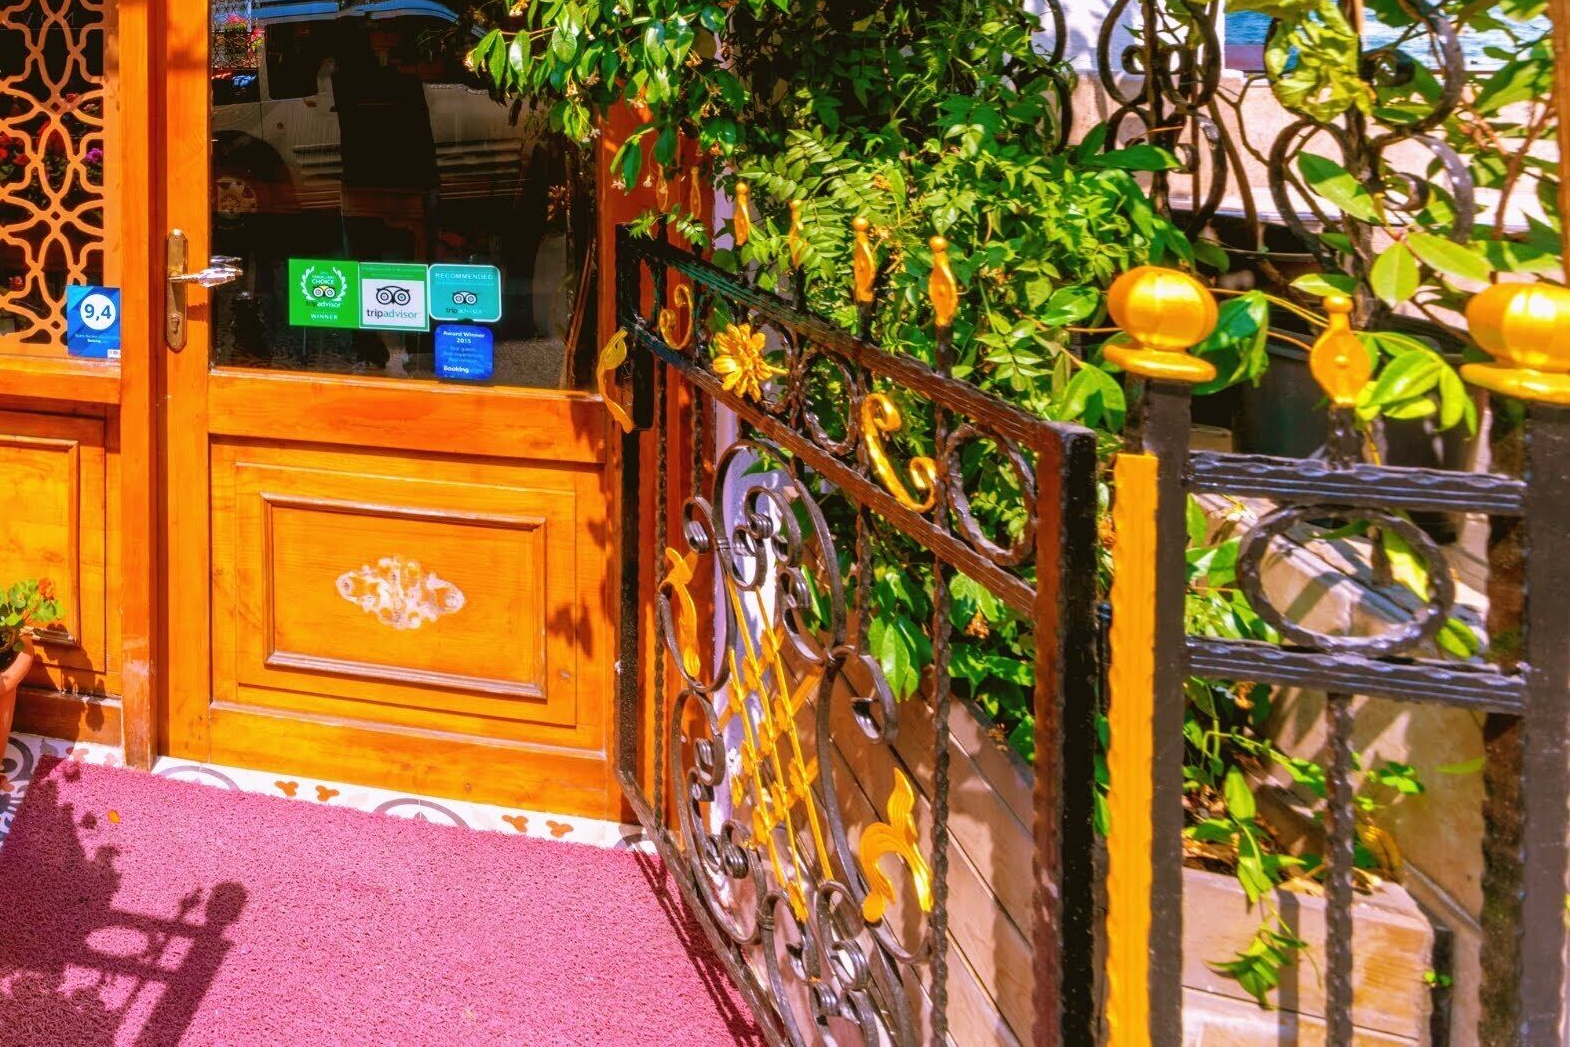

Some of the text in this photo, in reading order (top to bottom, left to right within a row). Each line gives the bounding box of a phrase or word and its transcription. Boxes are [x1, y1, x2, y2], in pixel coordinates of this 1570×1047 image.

[435, 272, 494, 280] RECOMMENDED
[84, 303, 112, 321] 9,4
[366, 309, 418, 319] tripadvisor
